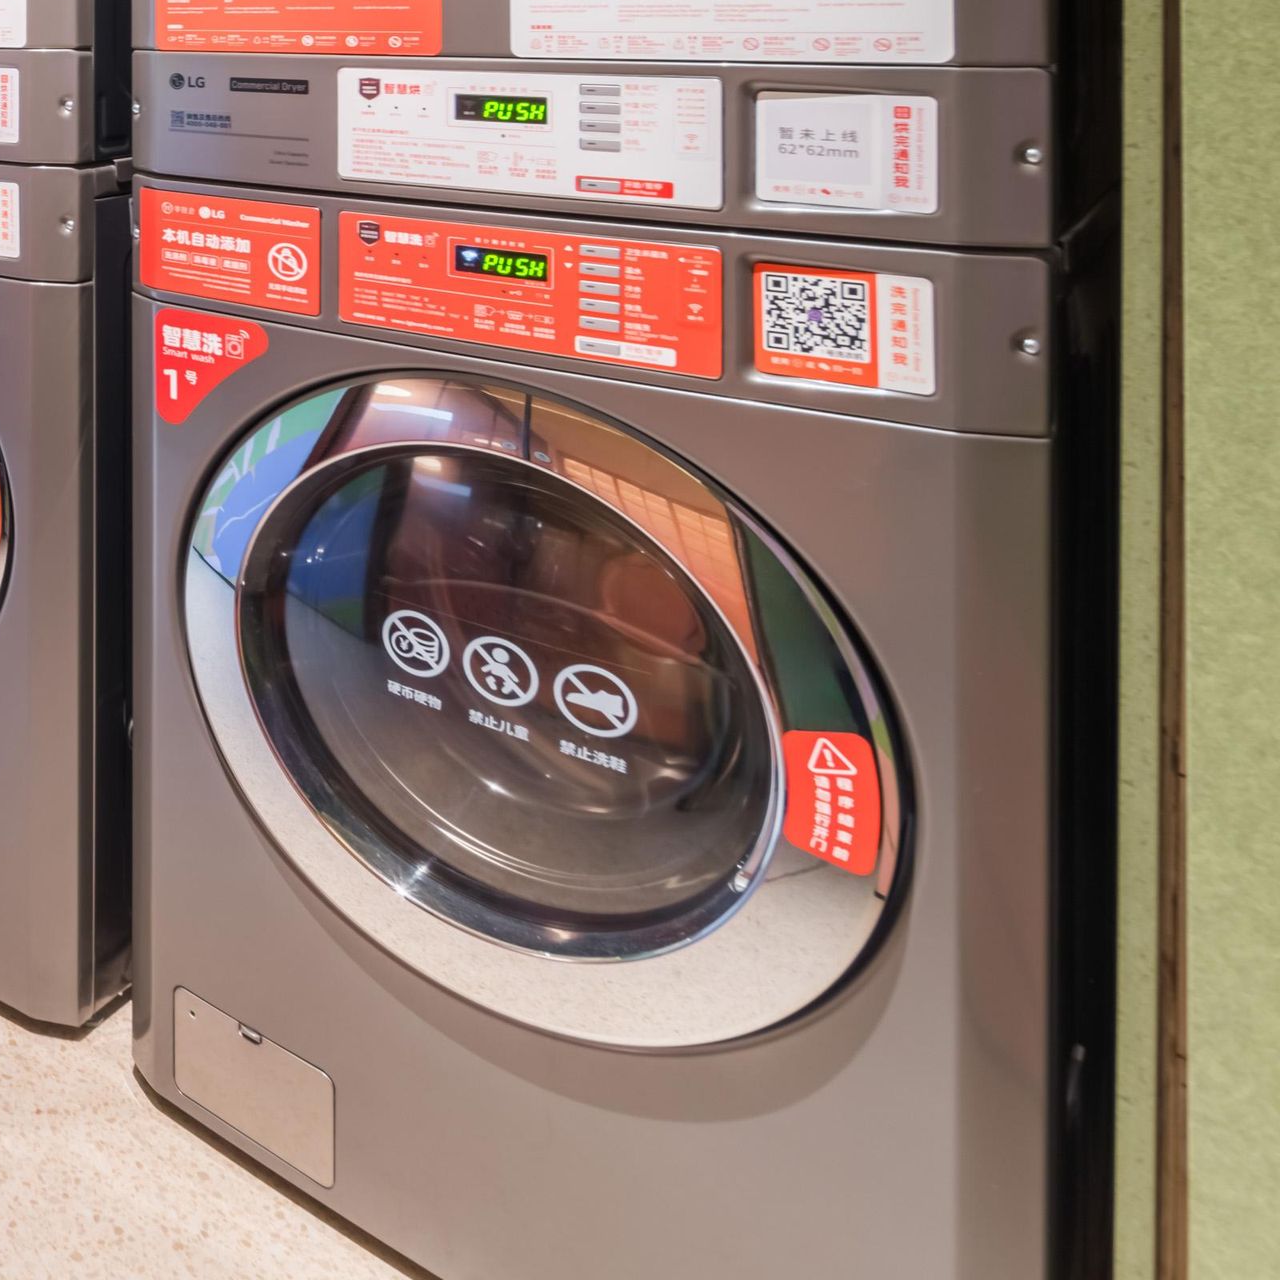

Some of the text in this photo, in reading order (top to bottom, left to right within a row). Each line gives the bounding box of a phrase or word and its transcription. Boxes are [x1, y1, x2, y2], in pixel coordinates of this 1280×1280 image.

[231, 80, 308, 93] Commercial Dryer
[384, 82, 422, 96] 智慧烘
[482, 101, 546, 122] PUSH
[778, 126, 859, 144] 暂未上线
[161, 227, 252, 254] 本机自动添加
[482, 253, 546, 279] PUSH
[162, 323, 223, 357] 智慧洗
[162, 346, 216, 364] Smart wash
[387, 678, 442, 711] 硬币硬物
[468, 708, 530, 743] 禁止儿童
[558, 738, 628, 774] 禁止洗鞋
